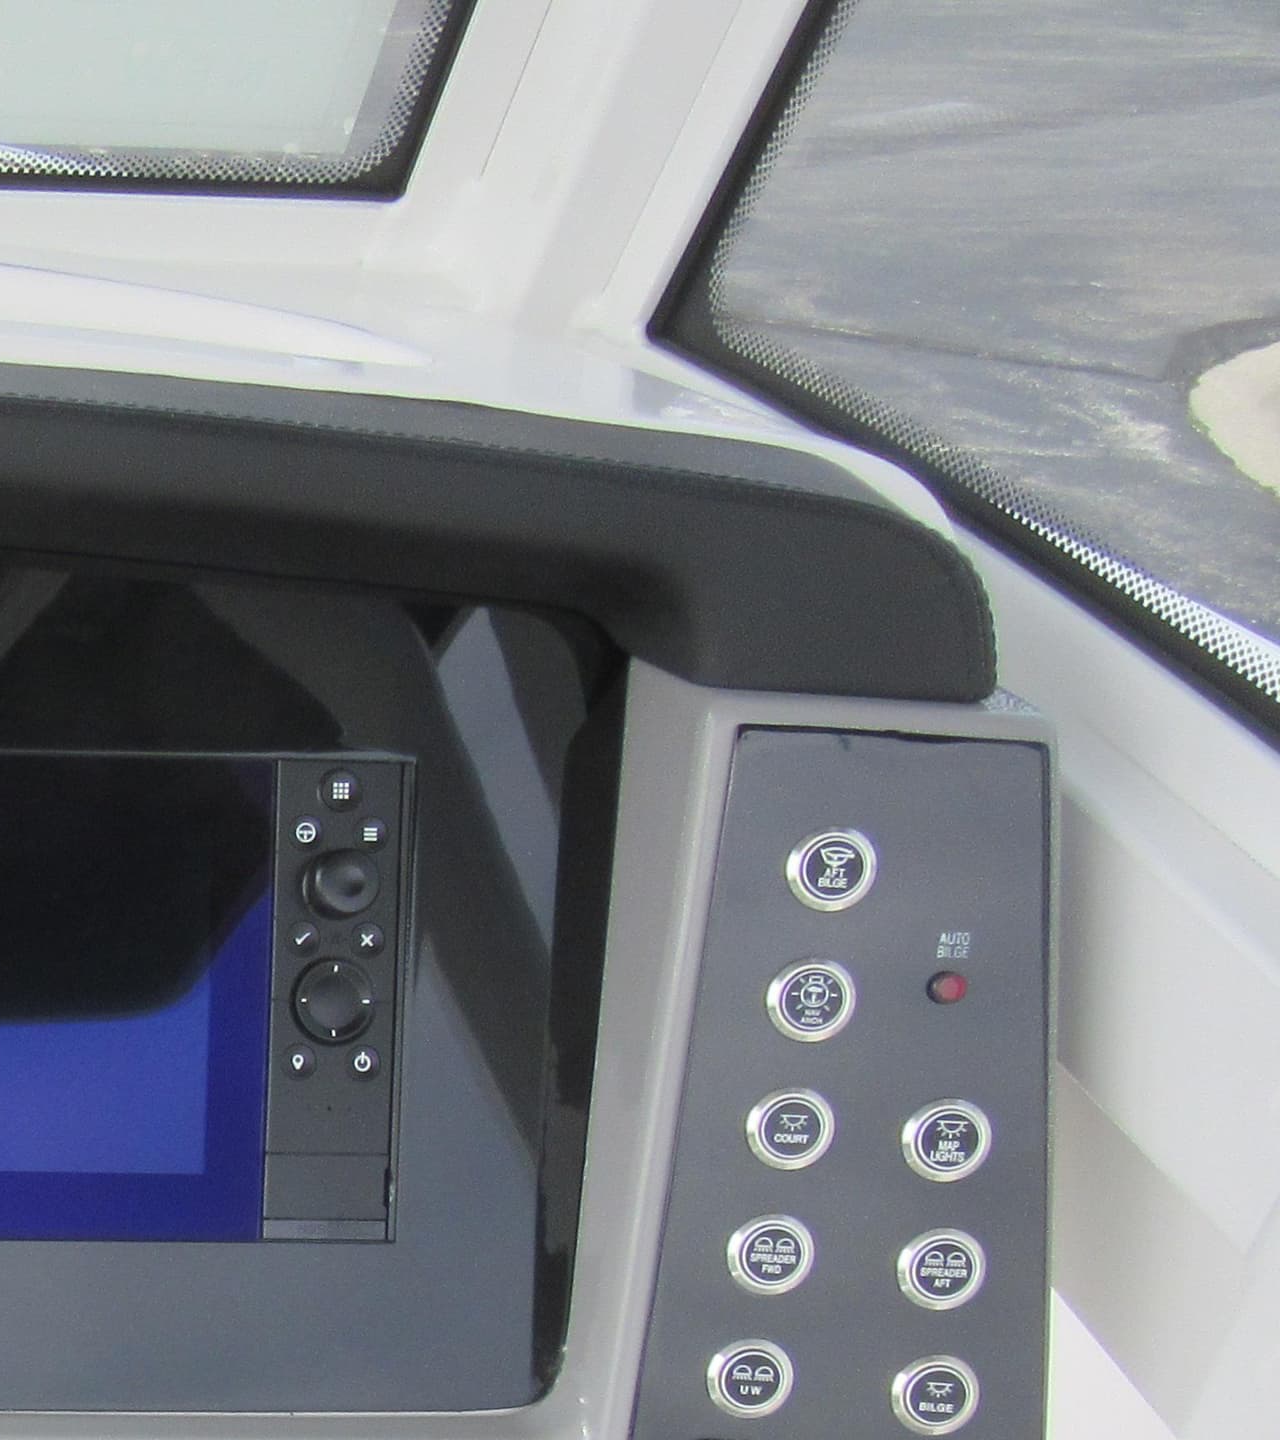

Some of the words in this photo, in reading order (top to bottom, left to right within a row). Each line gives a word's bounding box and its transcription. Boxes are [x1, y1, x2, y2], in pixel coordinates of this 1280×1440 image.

[824, 868, 846, 878] AFT
[818, 877, 848, 889] BILGE
[939, 932, 971, 946] AUTO
[936, 945, 970, 959] BILGE
[773, 1133, 809, 1145] COURT
[938, 1141, 960, 1152] MAP
[930, 1150, 966, 1164] LIGHTS
[750, 1253, 797, 1265] SPREADER
[761, 1264, 782, 1275] FWD
[920, 1267, 968, 1279] SPREADER
[933, 1277, 952, 1288] AFT
[918, 1402, 954, 1414] BILGE
